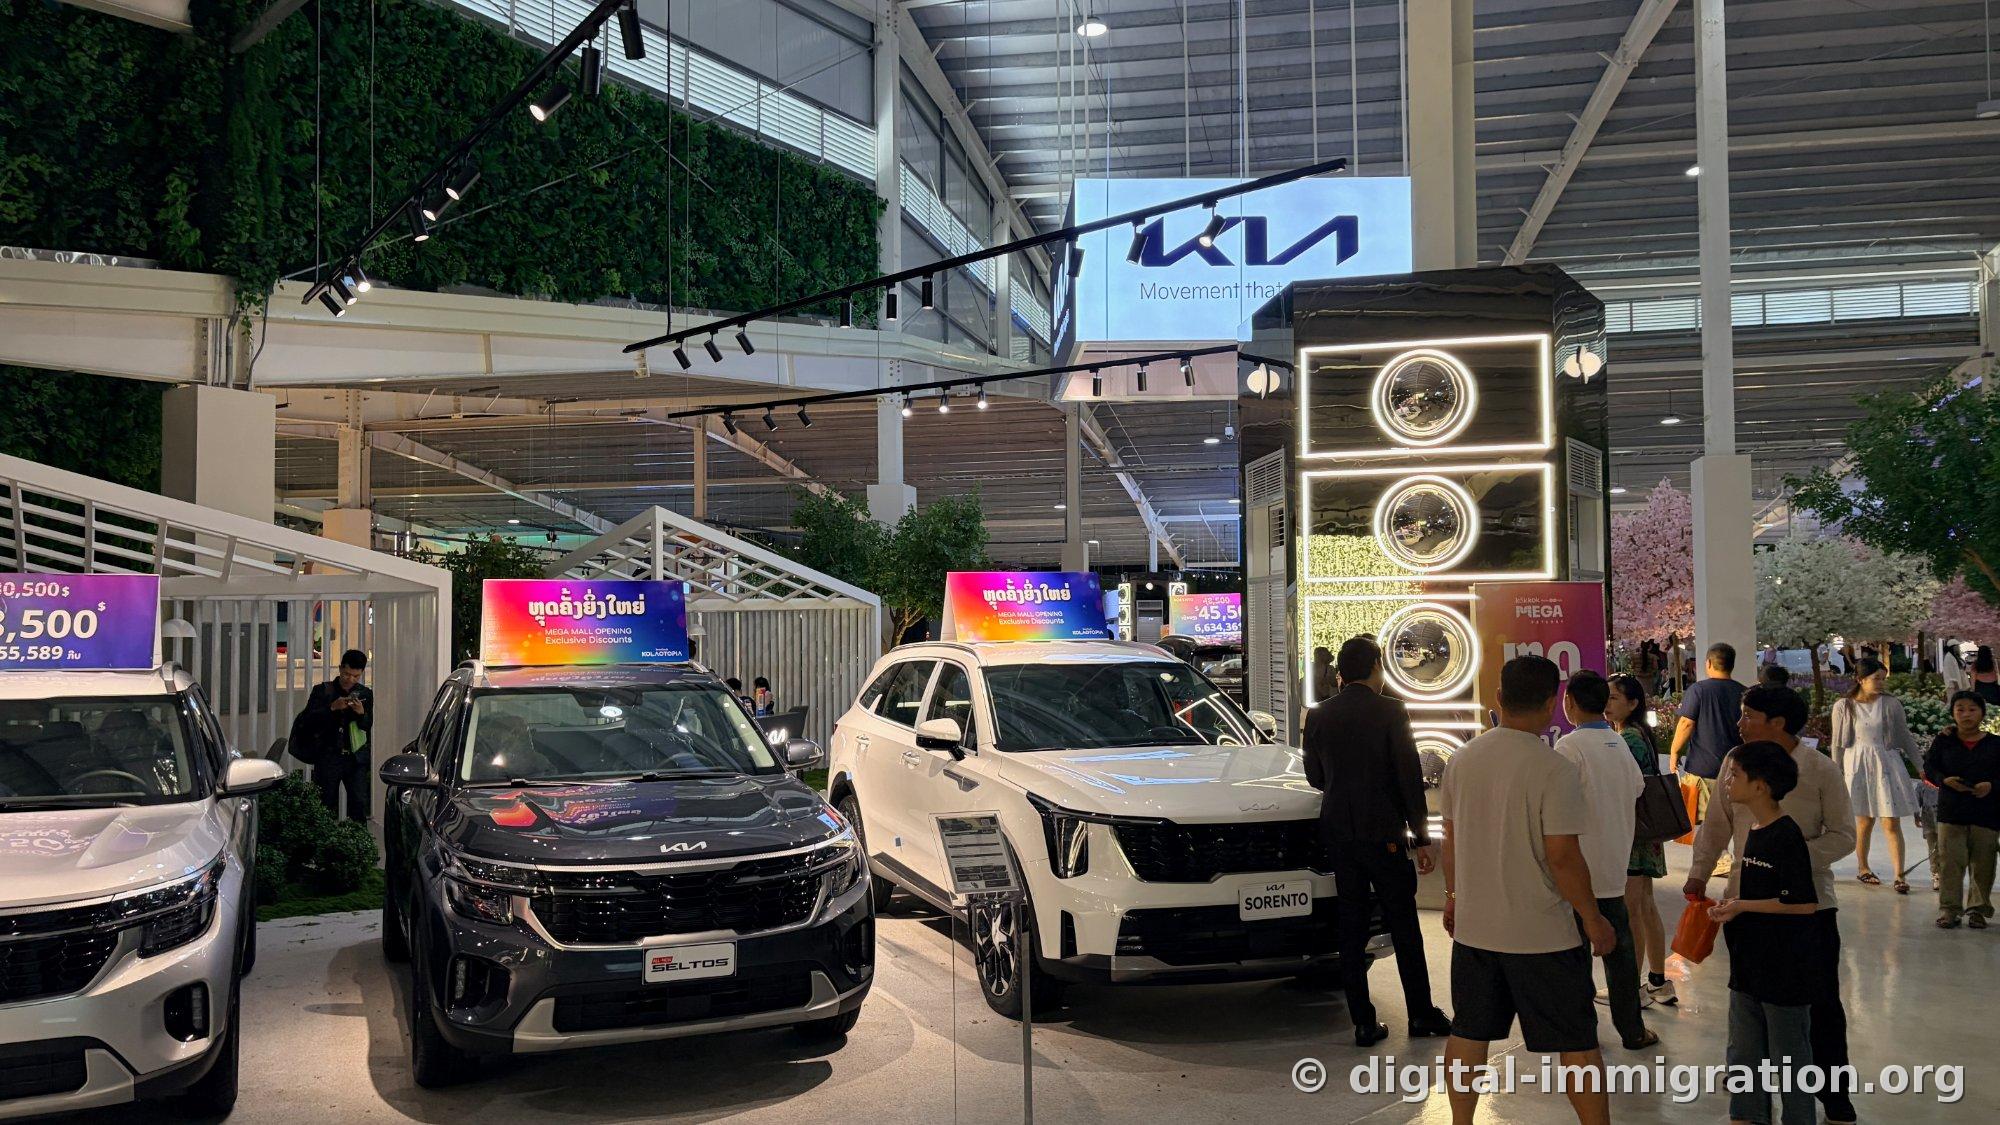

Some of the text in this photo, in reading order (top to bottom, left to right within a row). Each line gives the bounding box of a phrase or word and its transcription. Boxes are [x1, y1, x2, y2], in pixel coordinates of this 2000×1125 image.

[1140, 281, 1283, 300] Movement that
[0, 581, 70, 598] 0,500$
[1515, 604, 1564, 618] MEGA
[595, 627, 632, 635] OPENING
[545, 635, 633, 645] Exclusive Discounts
[1244, 892, 1308, 910] SORENTO
[651, 957, 730, 973] SELTOS
